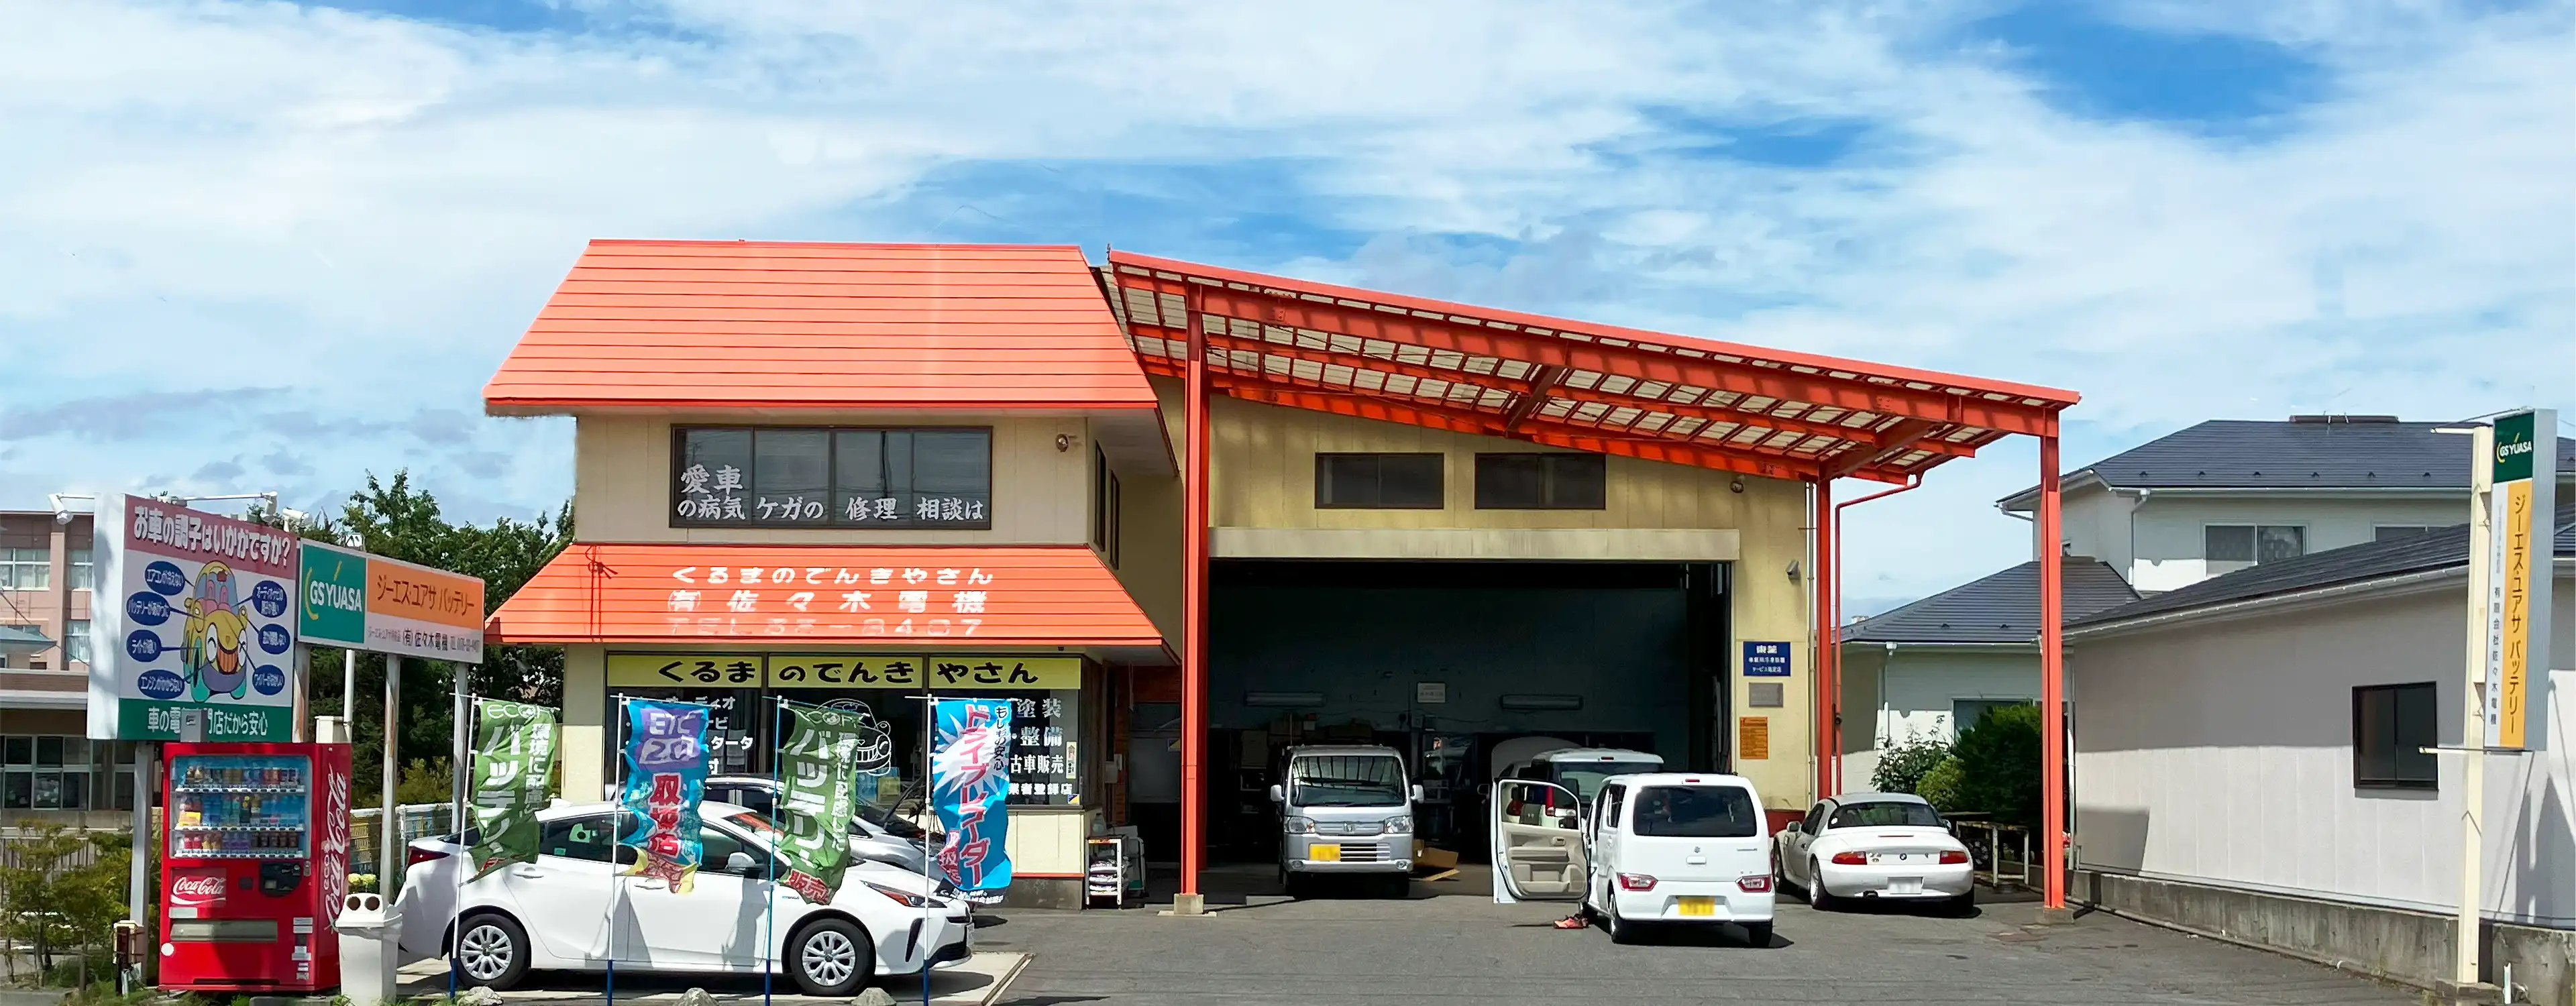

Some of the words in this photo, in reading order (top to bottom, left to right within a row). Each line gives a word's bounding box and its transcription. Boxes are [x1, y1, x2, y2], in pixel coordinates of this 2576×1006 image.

[680, 463, 743, 494] 愛車
[677, 495, 746, 520] の病気
[756, 496, 824, 520] ケガの
[845, 496, 898, 521] 修理
[916, 496, 983, 521] 相談は
[672, 566, 994, 585] くるまのでんきやさん
[325, 581, 363, 612] YUASA
[439, 587, 475, 616] バッテリー
[667, 616, 752, 636] TEL
[658, 661, 756, 683] くるま
[779, 661, 914, 683] のでんき
[936, 661, 1038, 684] やさん
[2510, 639, 2522, 734] バッテリー
[1016, 698, 1062, 718] 塗装
[959, 704, 991, 886] ドライブレコーダー
